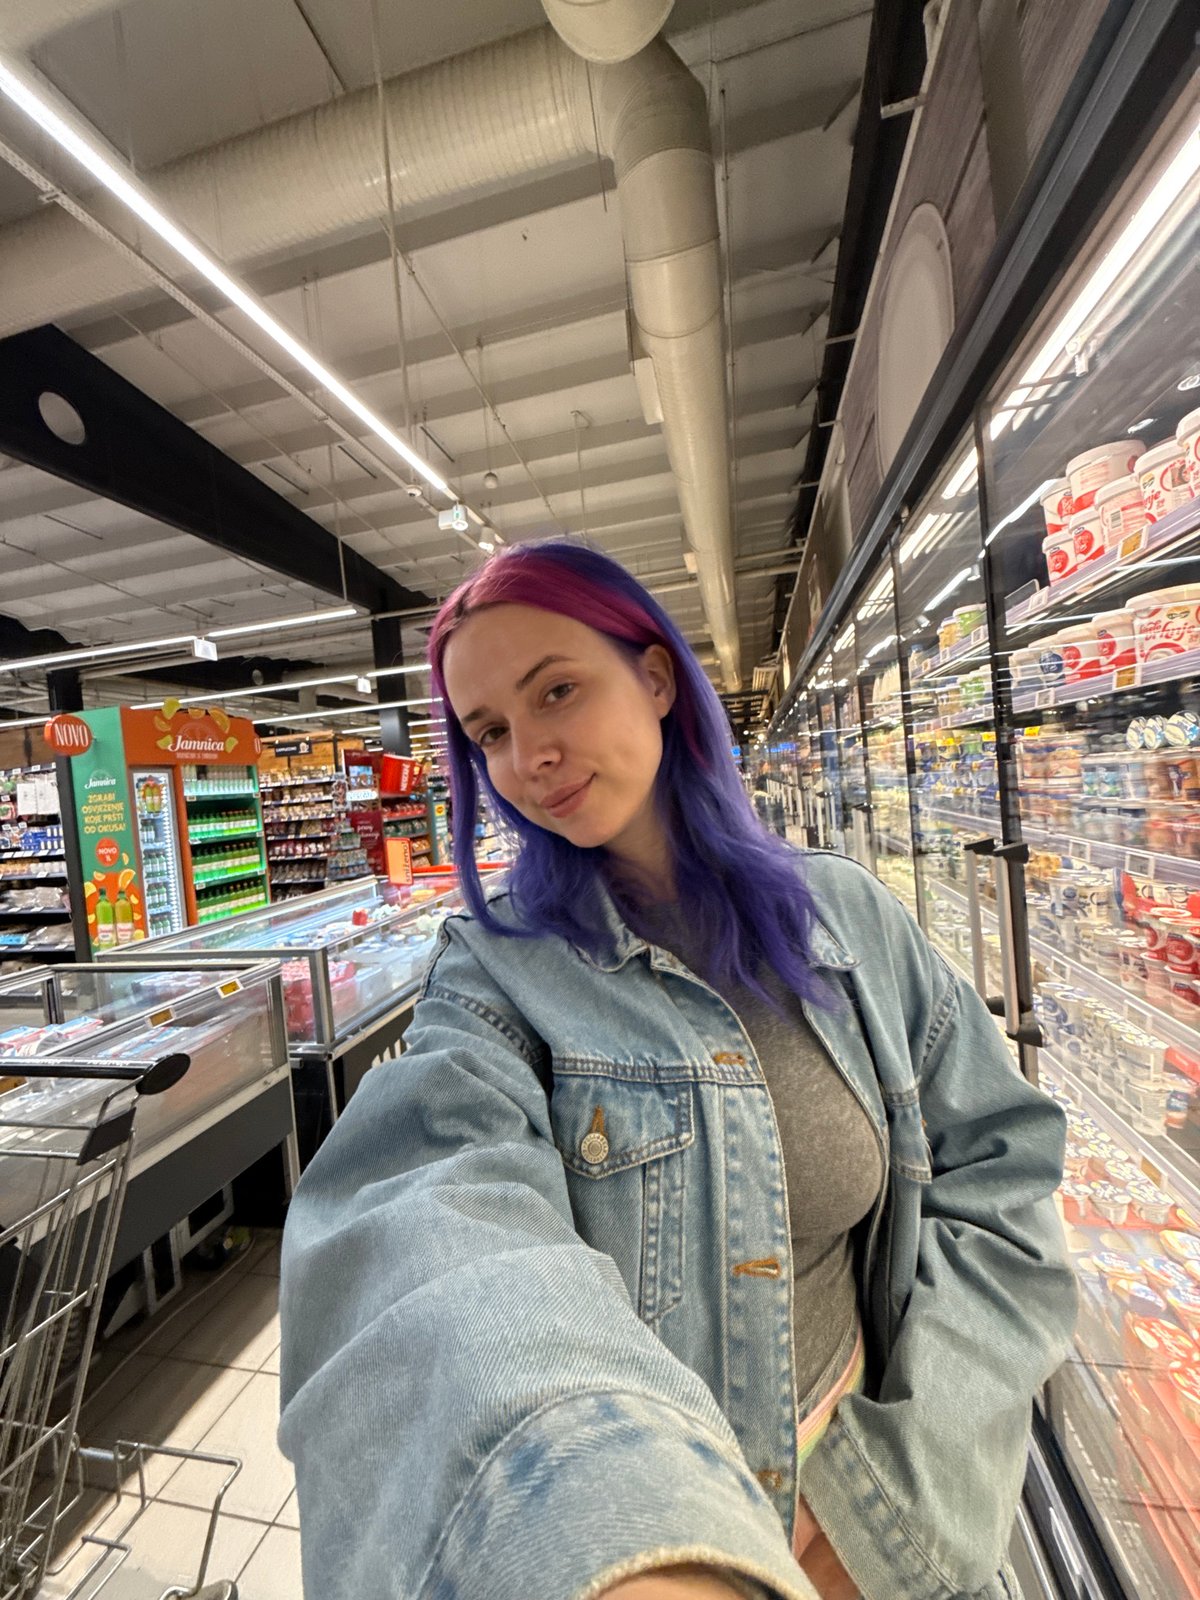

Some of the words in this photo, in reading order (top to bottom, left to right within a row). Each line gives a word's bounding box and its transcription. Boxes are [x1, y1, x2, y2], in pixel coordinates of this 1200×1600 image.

[54, 723, 89, 747] NOVO
[167, 735, 225, 752] Jamnica
[84, 777, 117, 790] Jamnica
[88, 792, 116, 804] ZGRABI
[98, 847, 118, 855] NOVO
